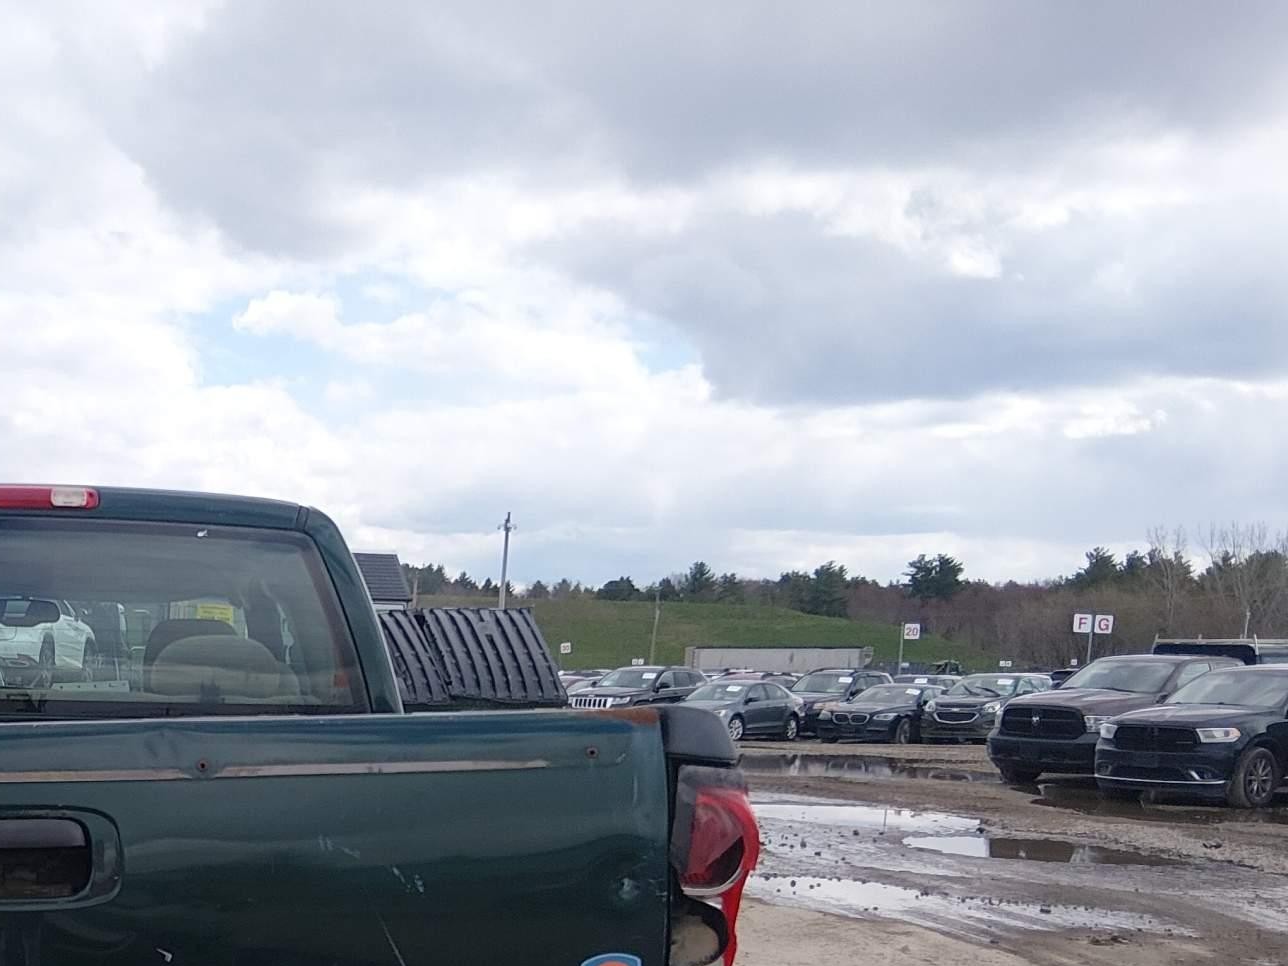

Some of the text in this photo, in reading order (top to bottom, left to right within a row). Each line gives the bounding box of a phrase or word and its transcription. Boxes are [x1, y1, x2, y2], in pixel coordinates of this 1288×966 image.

[1078, 617, 1088, 630] F
[1098, 618, 1110, 631] G
[905, 627, 919, 637] 20
